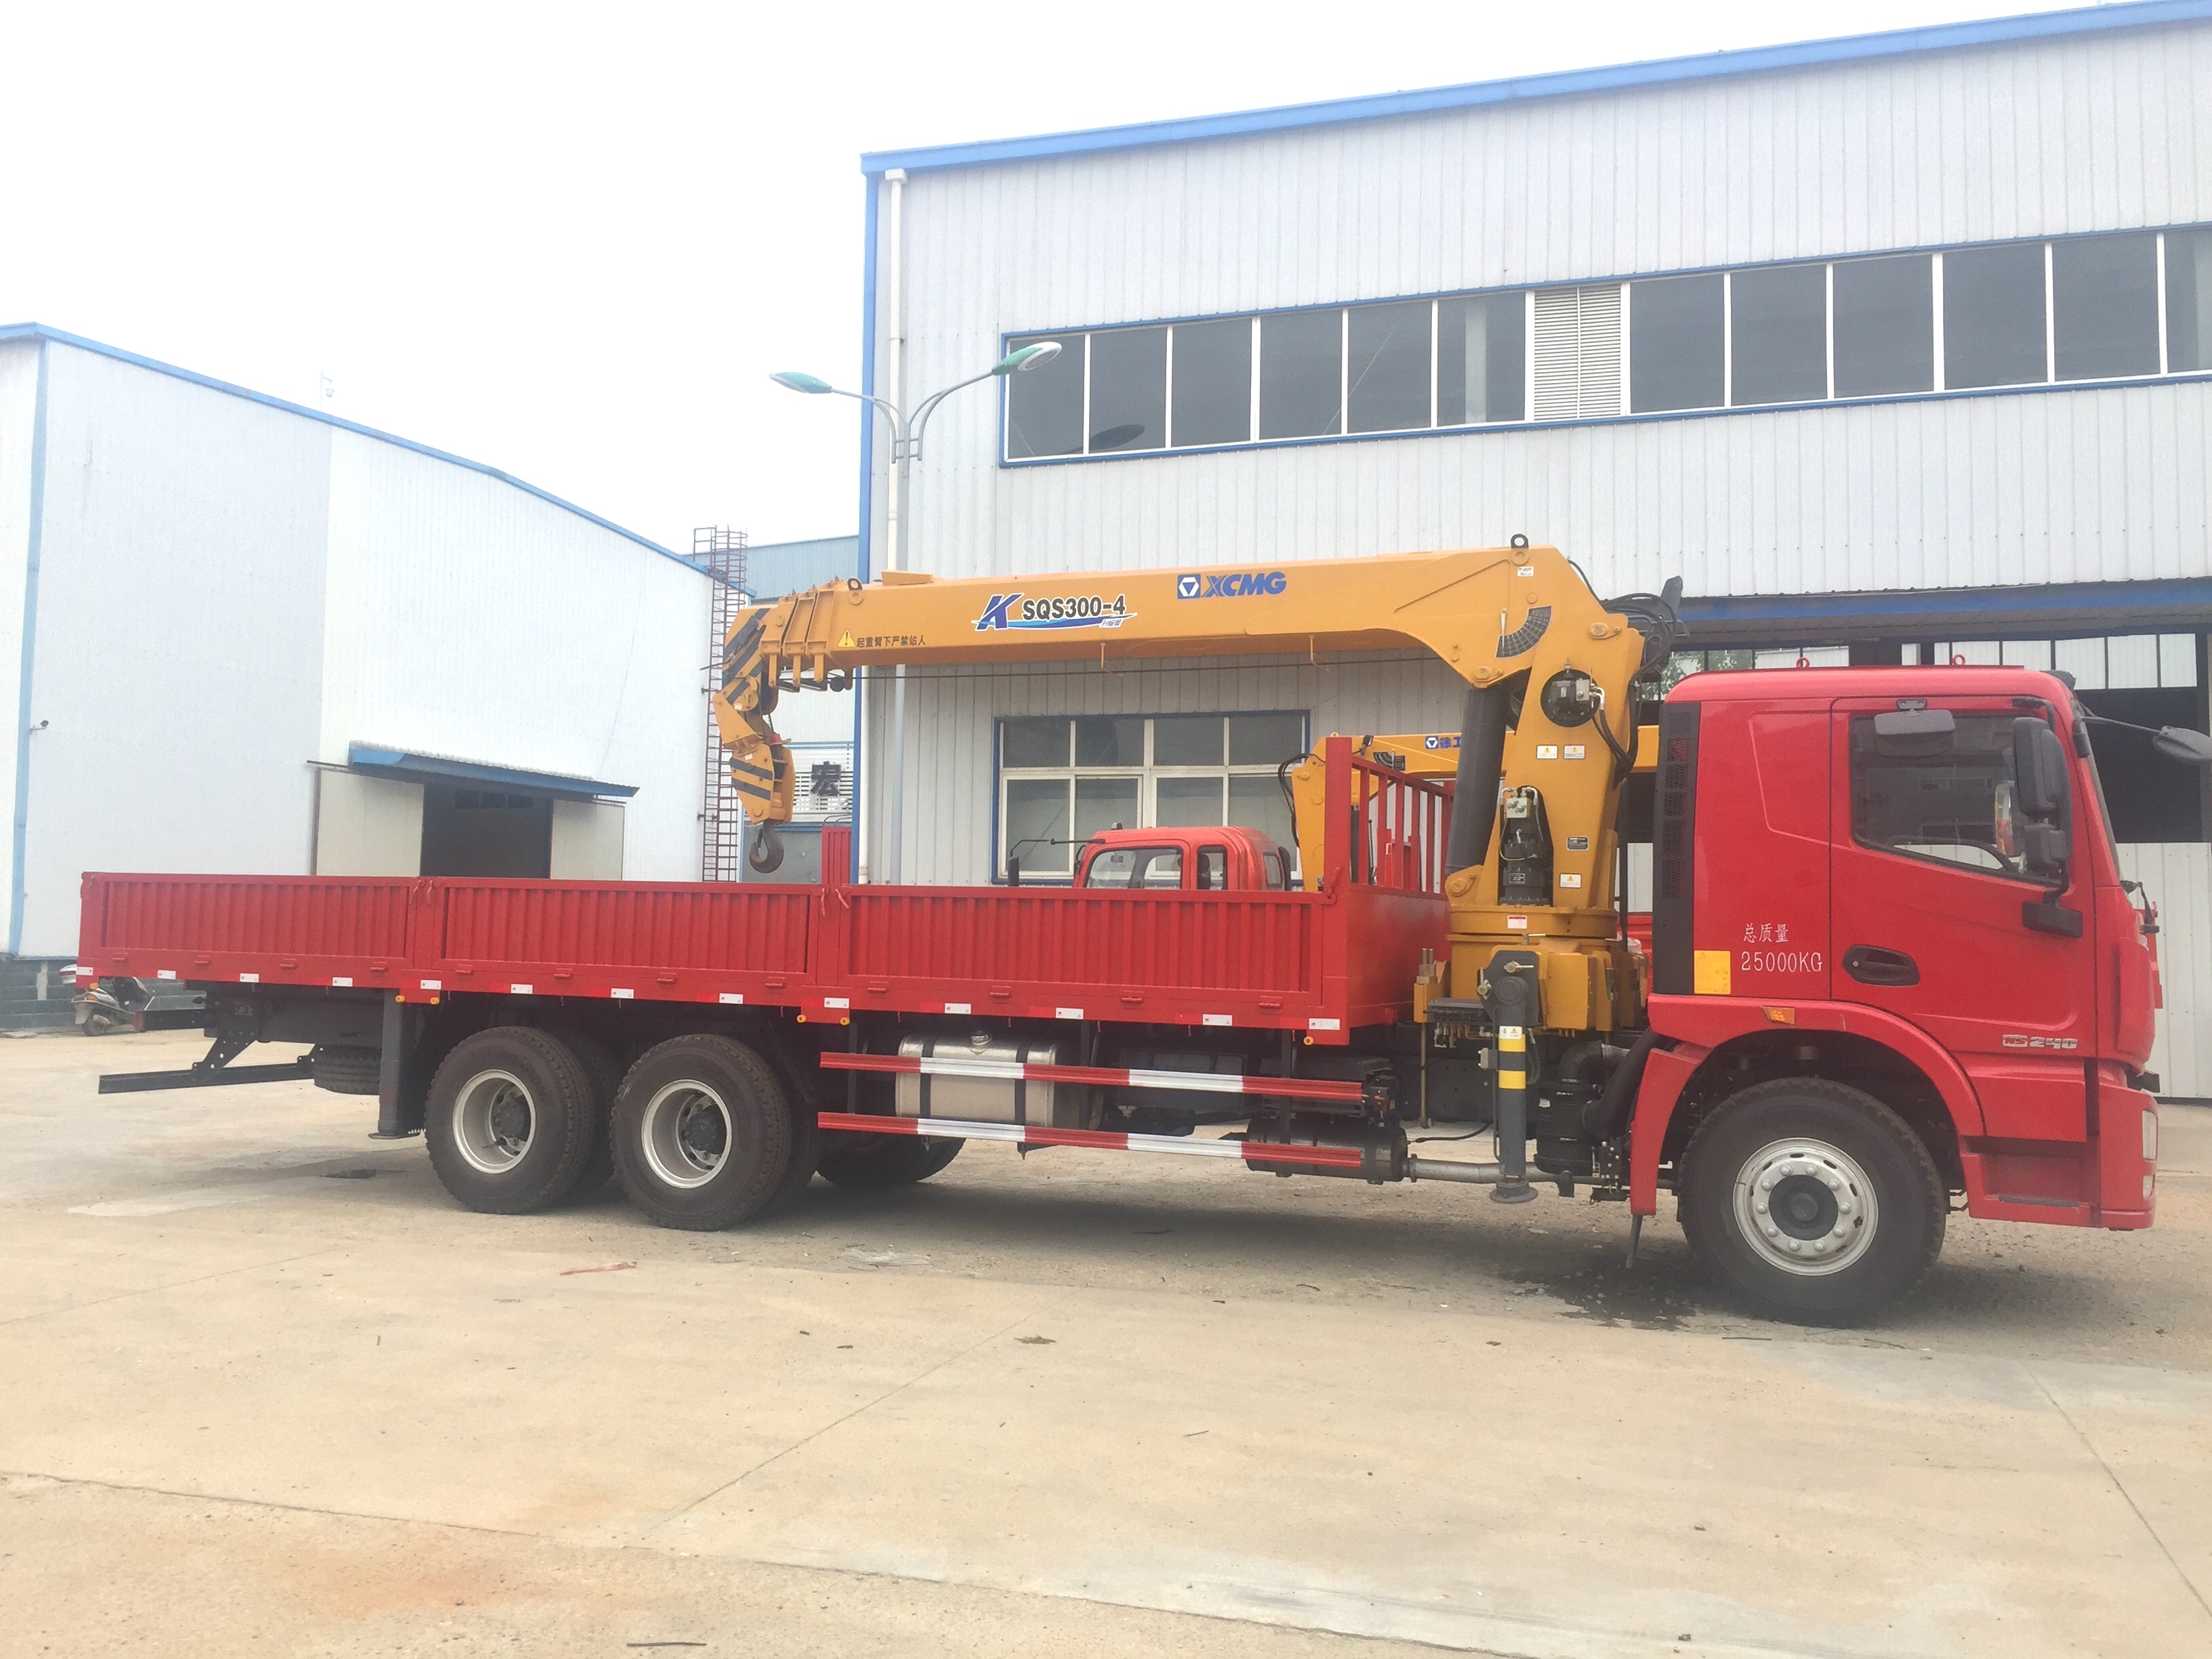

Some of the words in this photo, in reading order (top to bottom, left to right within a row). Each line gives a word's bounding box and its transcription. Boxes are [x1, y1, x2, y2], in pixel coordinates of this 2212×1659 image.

[1202, 571, 1287, 598] XCMG
[1023, 595, 1125, 620] SQS300-4
[856, 635, 926, 648] 起重臂下严禁站人
[1743, 922, 1788, 943] 总质量
[1741, 951, 1822, 972] 25000KG
[2029, 1036, 2078, 1049] 240
